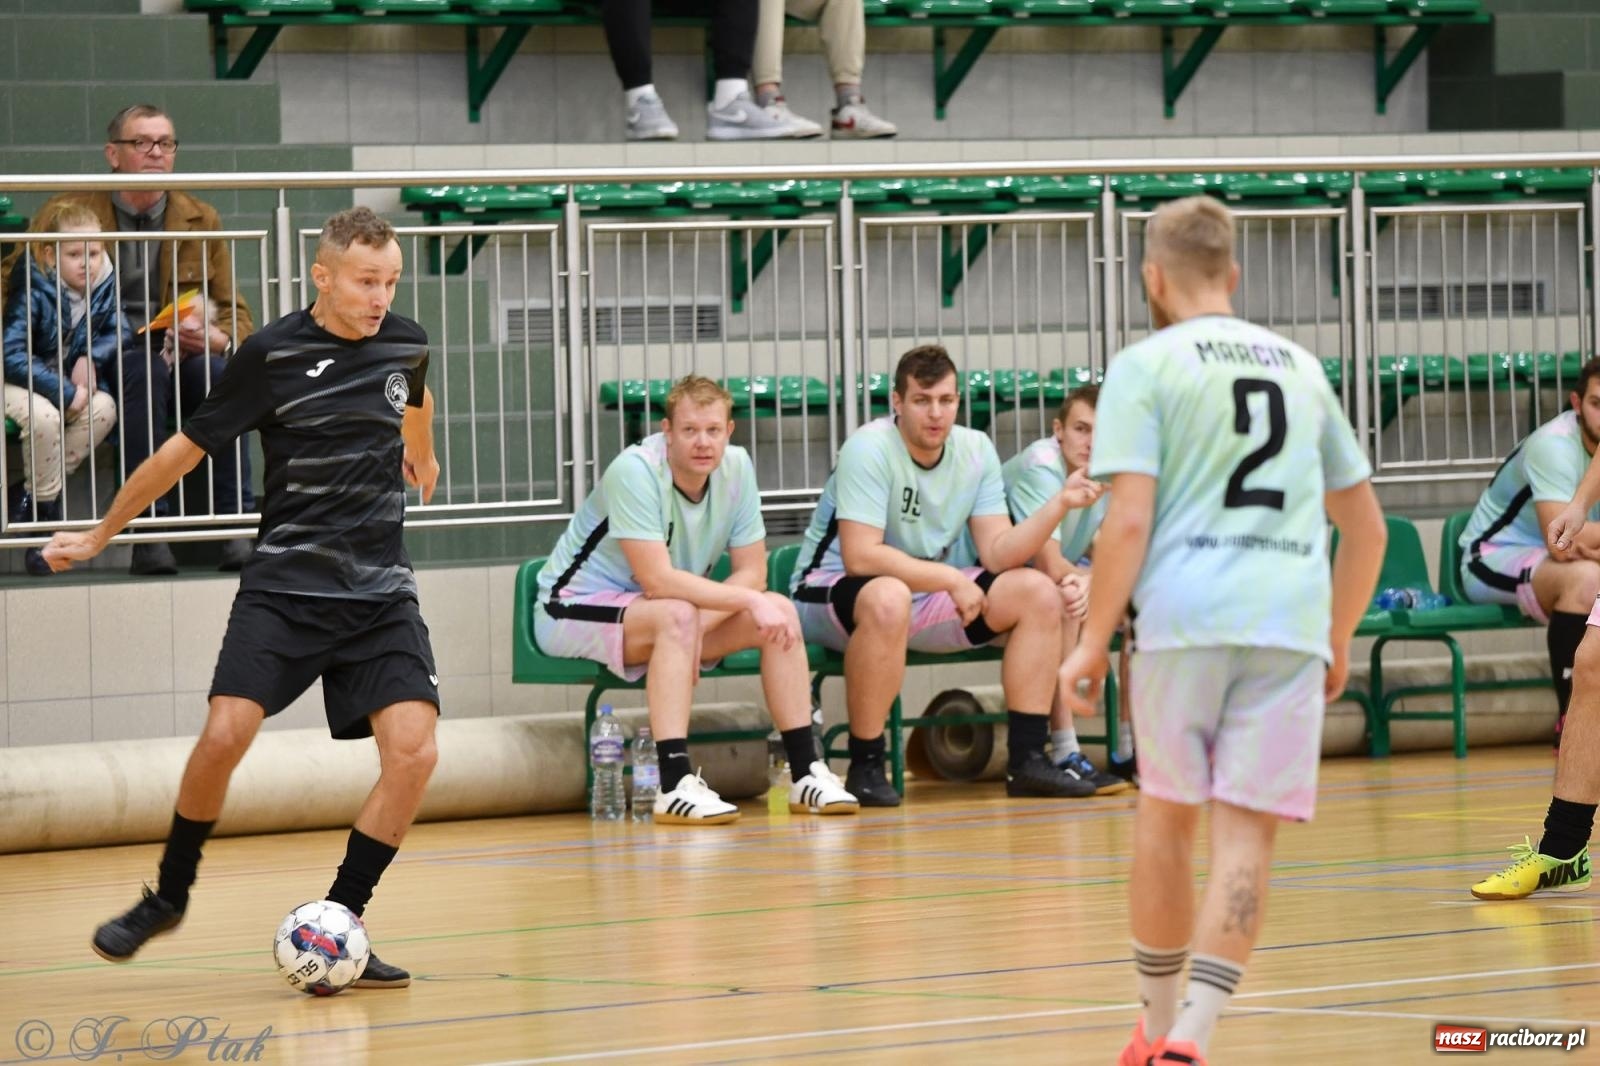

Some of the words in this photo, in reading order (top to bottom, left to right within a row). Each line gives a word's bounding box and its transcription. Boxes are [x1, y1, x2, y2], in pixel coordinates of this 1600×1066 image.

[1224, 378, 1287, 511] 2
[1535, 850, 1590, 890] NIKE
[287, 959, 319, 986] SELEC
